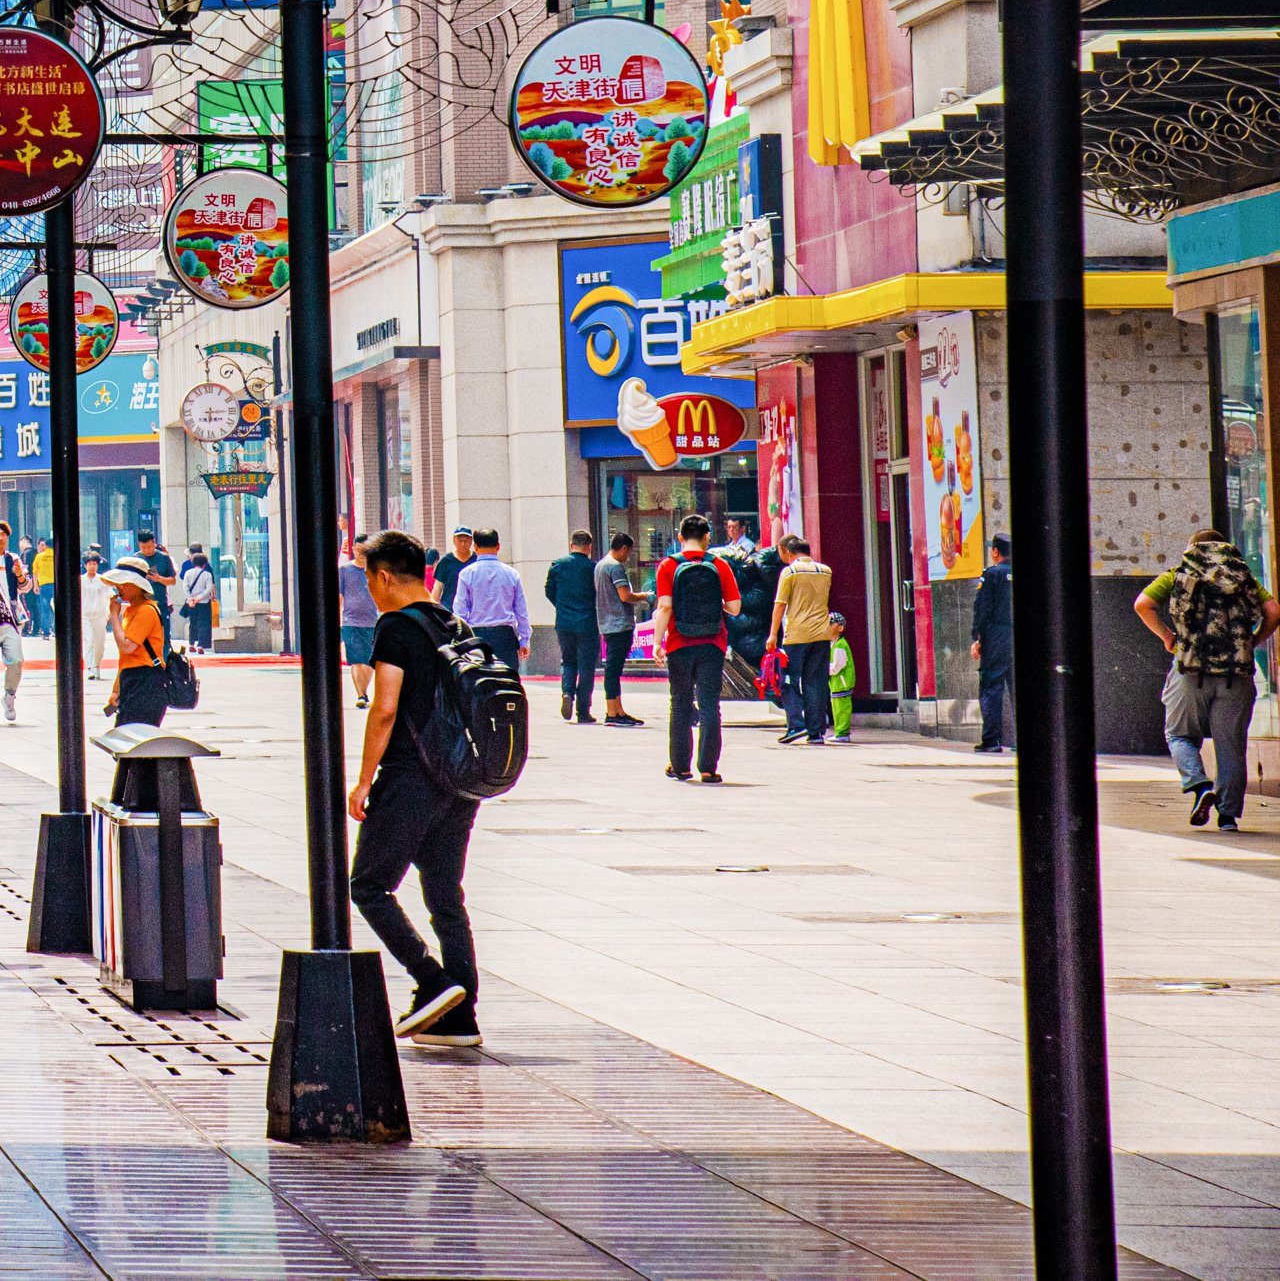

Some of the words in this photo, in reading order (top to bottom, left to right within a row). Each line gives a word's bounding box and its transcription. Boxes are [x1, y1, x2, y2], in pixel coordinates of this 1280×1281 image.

[555, 54, 602, 75] 文明
[543, 78, 619, 101] 天津街
[613, 112, 641, 168] 讲诚信
[585, 128, 614, 184] 有良心
[204, 193, 236, 207] 文明
[195, 210, 245, 225] 天津街
[219, 244, 237, 283] 有良心
[239, 235, 255, 274] 讲诚信
[675, 436, 720, 448] 甜品站
